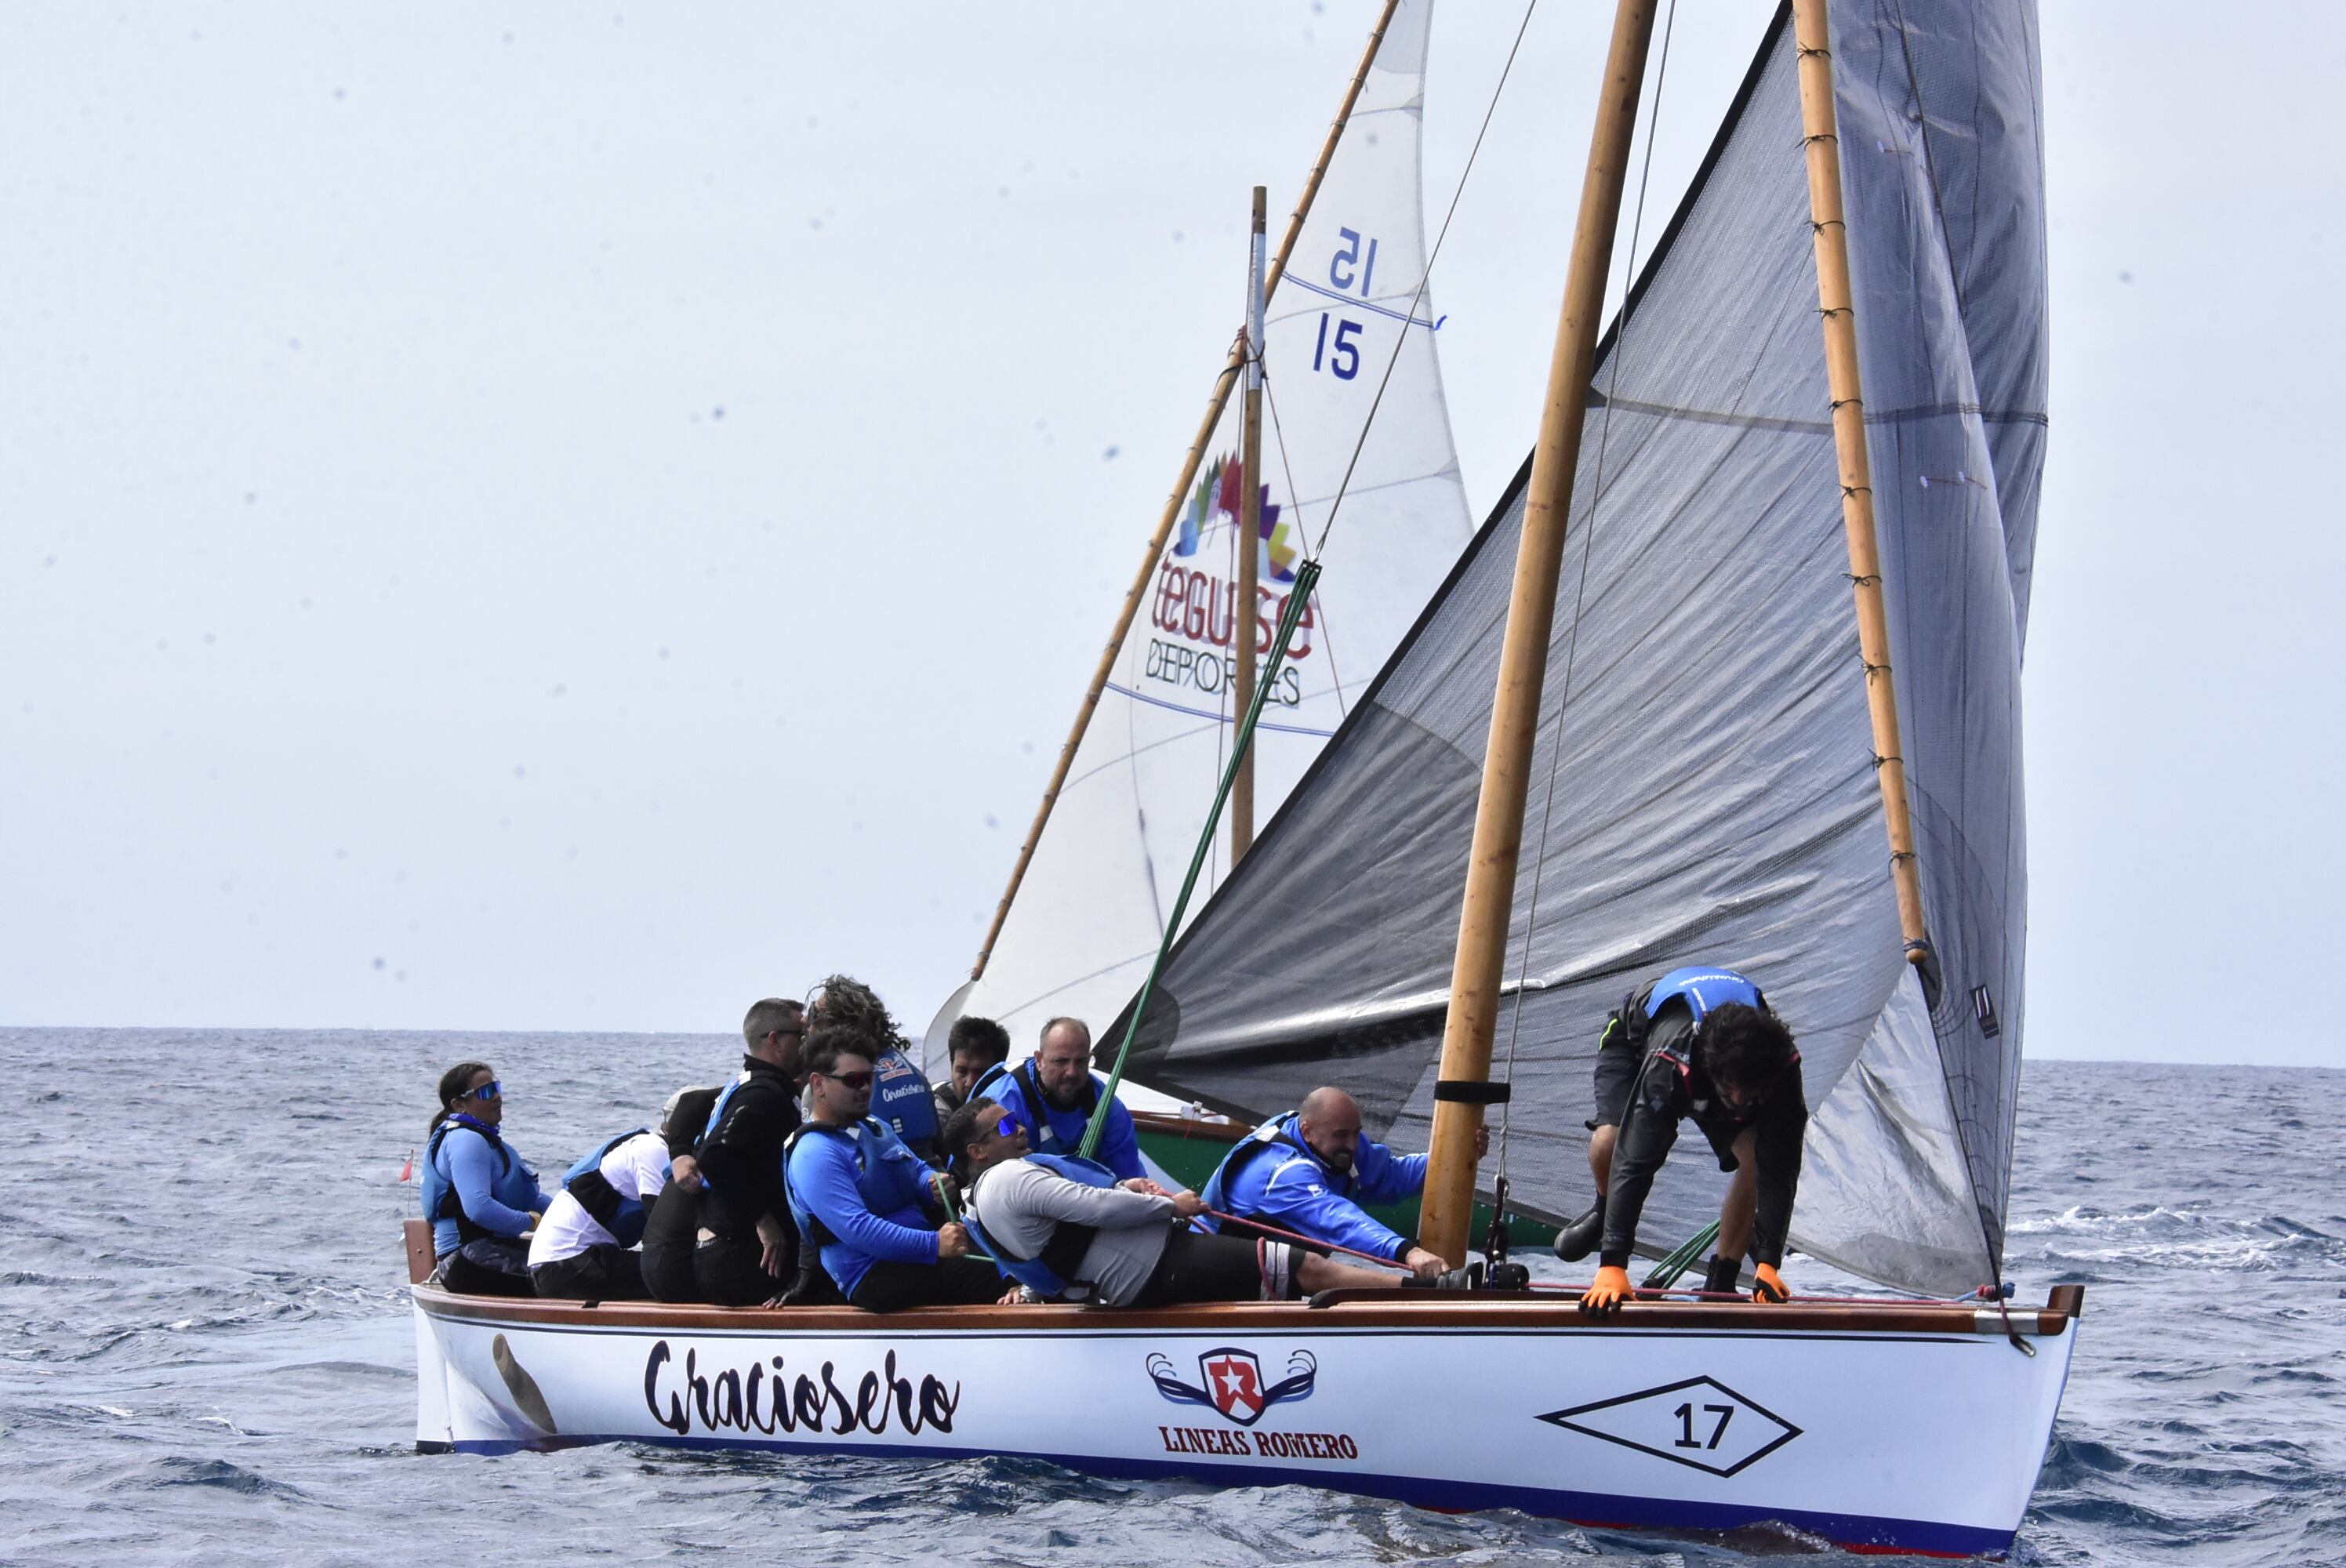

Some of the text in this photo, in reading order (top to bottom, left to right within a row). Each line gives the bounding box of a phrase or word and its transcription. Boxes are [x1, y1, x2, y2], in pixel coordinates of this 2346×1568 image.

[1313, 312, 1363, 381] 15
[1146, 637, 1300, 706] DEPORS
[645, 1340, 961, 1436] Graciosero
[1158, 1425, 1358, 1460] LINEAS ROMERO
[1673, 1403, 1734, 1450] 17
